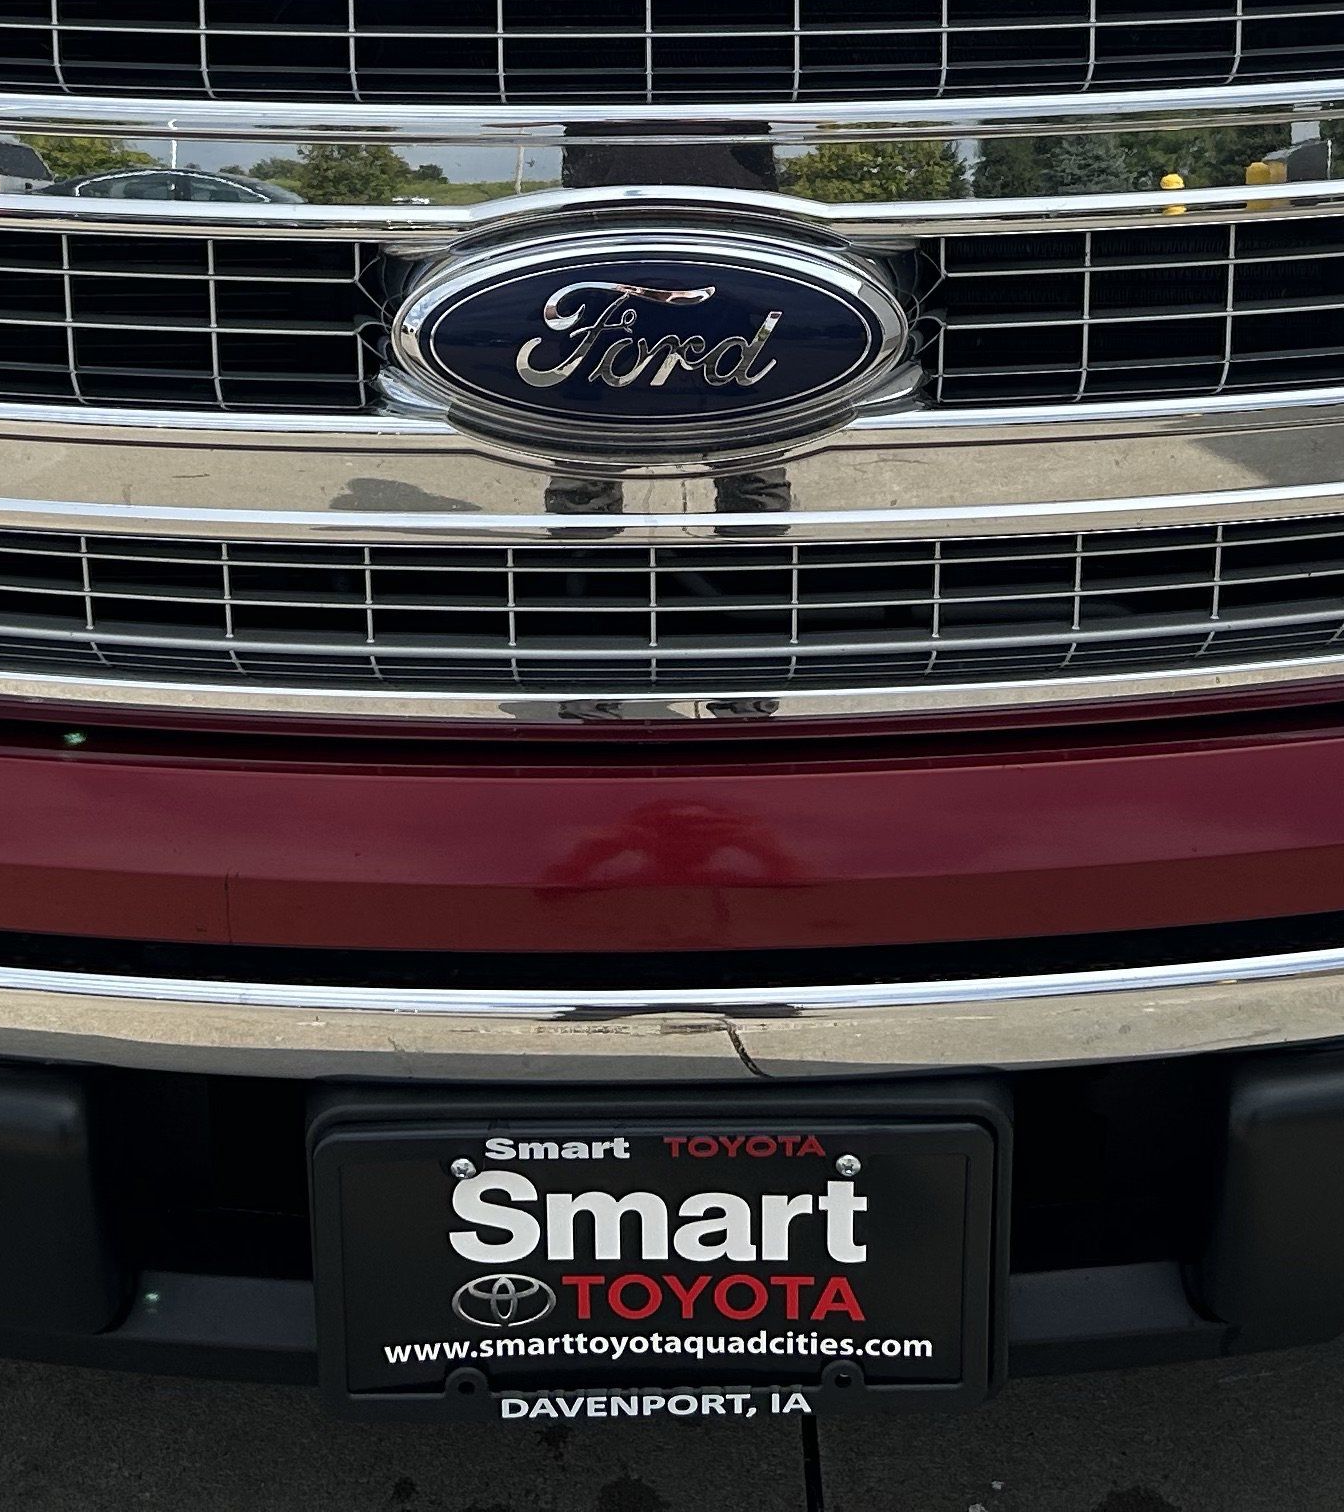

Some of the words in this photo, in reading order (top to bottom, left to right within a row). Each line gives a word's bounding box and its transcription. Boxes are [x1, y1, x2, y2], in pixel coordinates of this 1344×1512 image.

[515, 281, 783, 388] Ford
[484, 1137, 631, 1160] Smart
[663, 1136, 825, 1157] TOYOTA
[448, 1169, 868, 1264] Smart
[562, 1273, 865, 1321] TOYOTA
[383, 1329, 933, 1365] www.smarttoyotaquadcities.com
[501, 1393, 757, 1419] DAVENPORT,
[771, 1392, 812, 1414] IA
